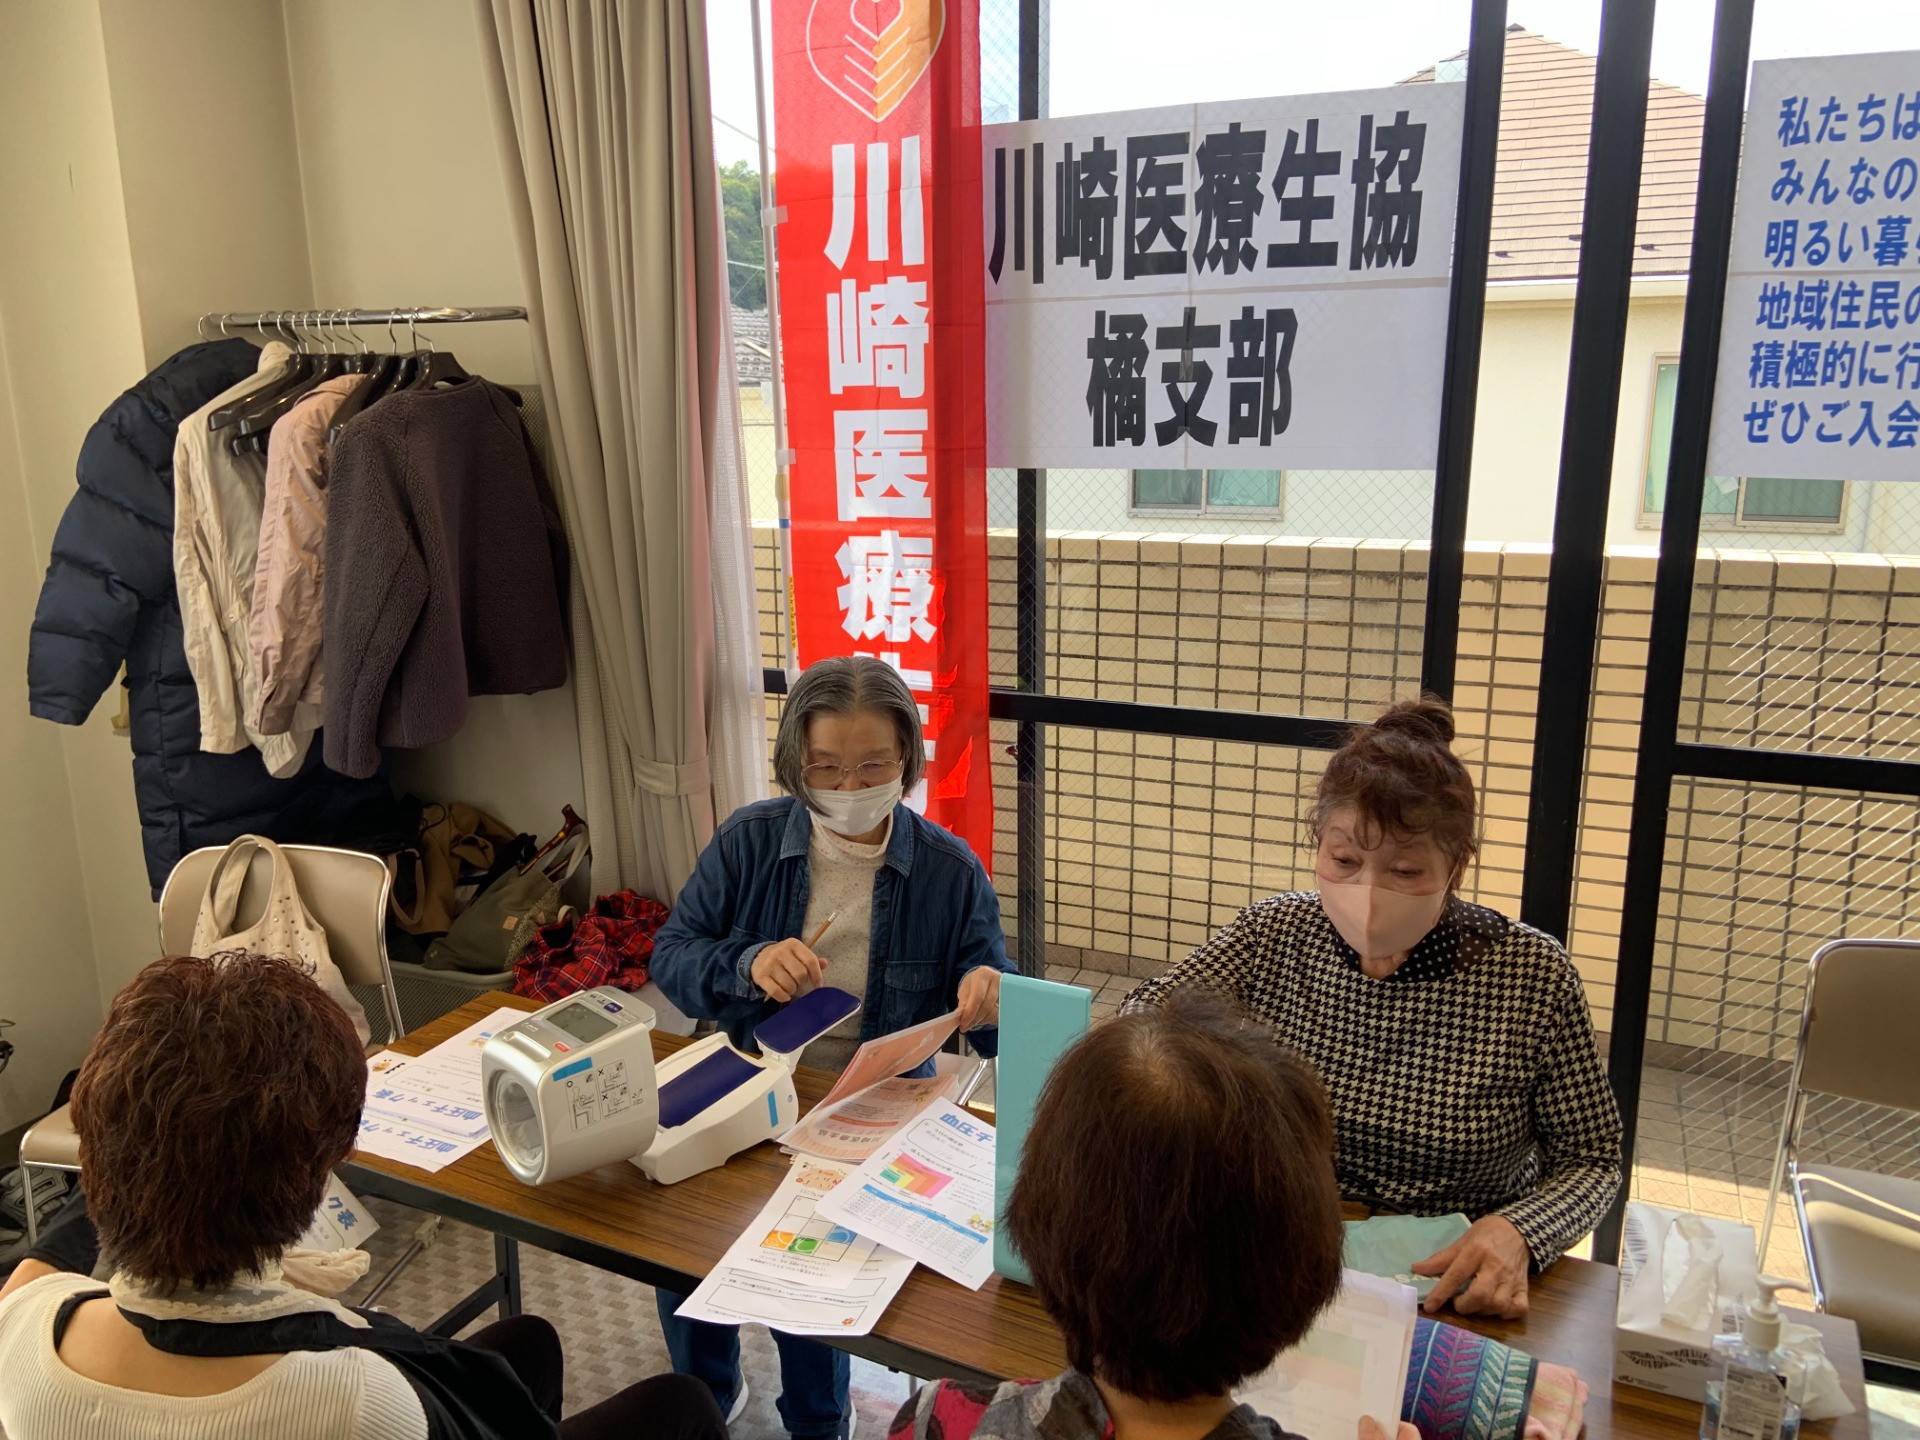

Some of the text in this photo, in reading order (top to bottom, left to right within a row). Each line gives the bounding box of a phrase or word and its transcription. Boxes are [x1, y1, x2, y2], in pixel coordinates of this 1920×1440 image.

[988, 111, 1427, 285] 川崎医療生協
[1771, 156, 1918, 206] みんなの
[1764, 215, 1920, 268] 明るい暮
[1085, 306, 1299, 448] 橘支部
[1748, 340, 1920, 390] 積極的に行
[1743, 399, 1920, 449] ぜひご入会
[939, 1112, 996, 1148] 血圧チ
